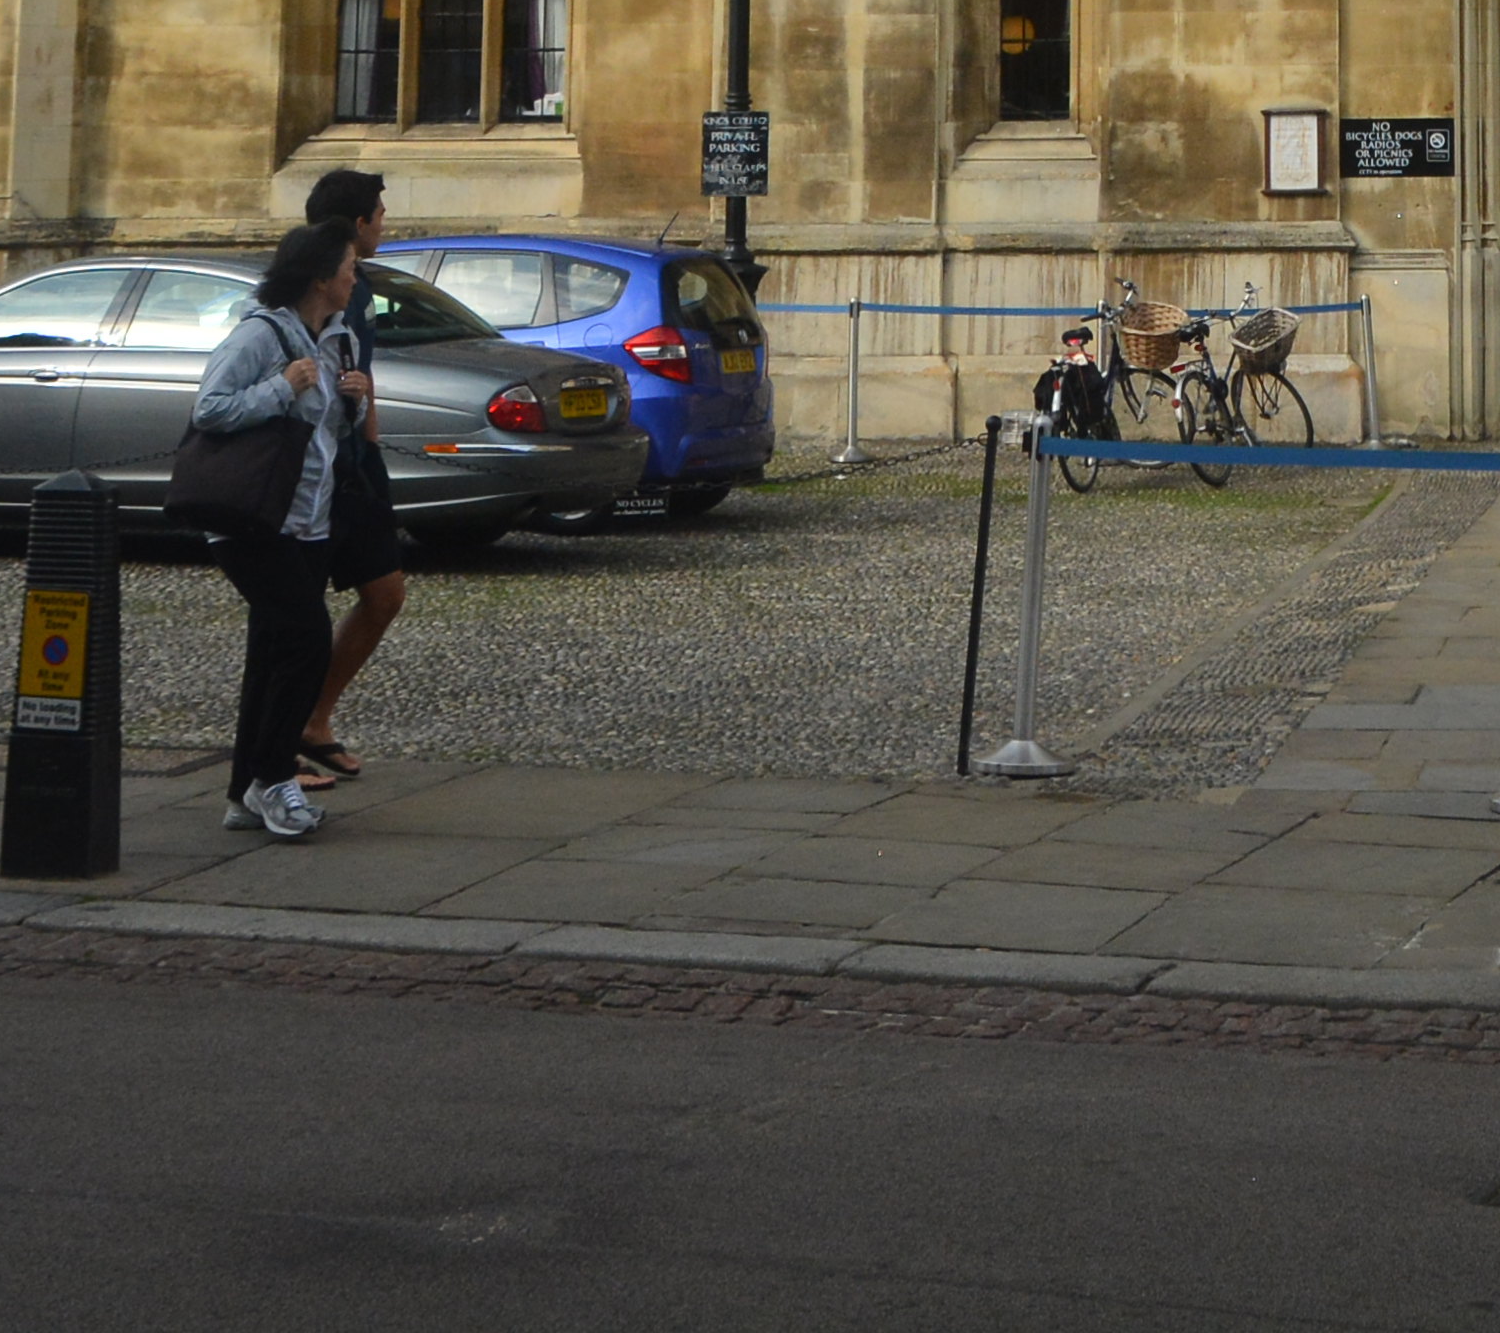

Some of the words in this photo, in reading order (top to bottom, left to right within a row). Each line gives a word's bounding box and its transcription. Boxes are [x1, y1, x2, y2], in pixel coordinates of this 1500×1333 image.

[1371, 121, 1391, 132] NO
[1345, 131, 1392, 141] BICYCLES
[1394, 131, 1423, 141] DOGS
[708, 143, 760, 153] PARKING
[1360, 140, 1402, 150] RADIOS
[1355, 149, 1371, 159] OR
[1374, 148, 1414, 158] PICNICS
[1357, 158, 1410, 168] ALLOWED
[616, 500, 629, 508] NO
[630, 498, 664, 508] CYCLES
[33, 594, 86, 607] Restricted
[38, 607, 78, 621] Parking
[44, 619, 69, 630] Zone
[37, 668, 50, 679] At
[51, 671, 70, 682] any
[41, 681, 65, 692] time
[21, 700, 37, 711] No
[39, 701, 77, 715] loading
[19, 712, 31, 724] at
[33, 714, 52, 726] any
